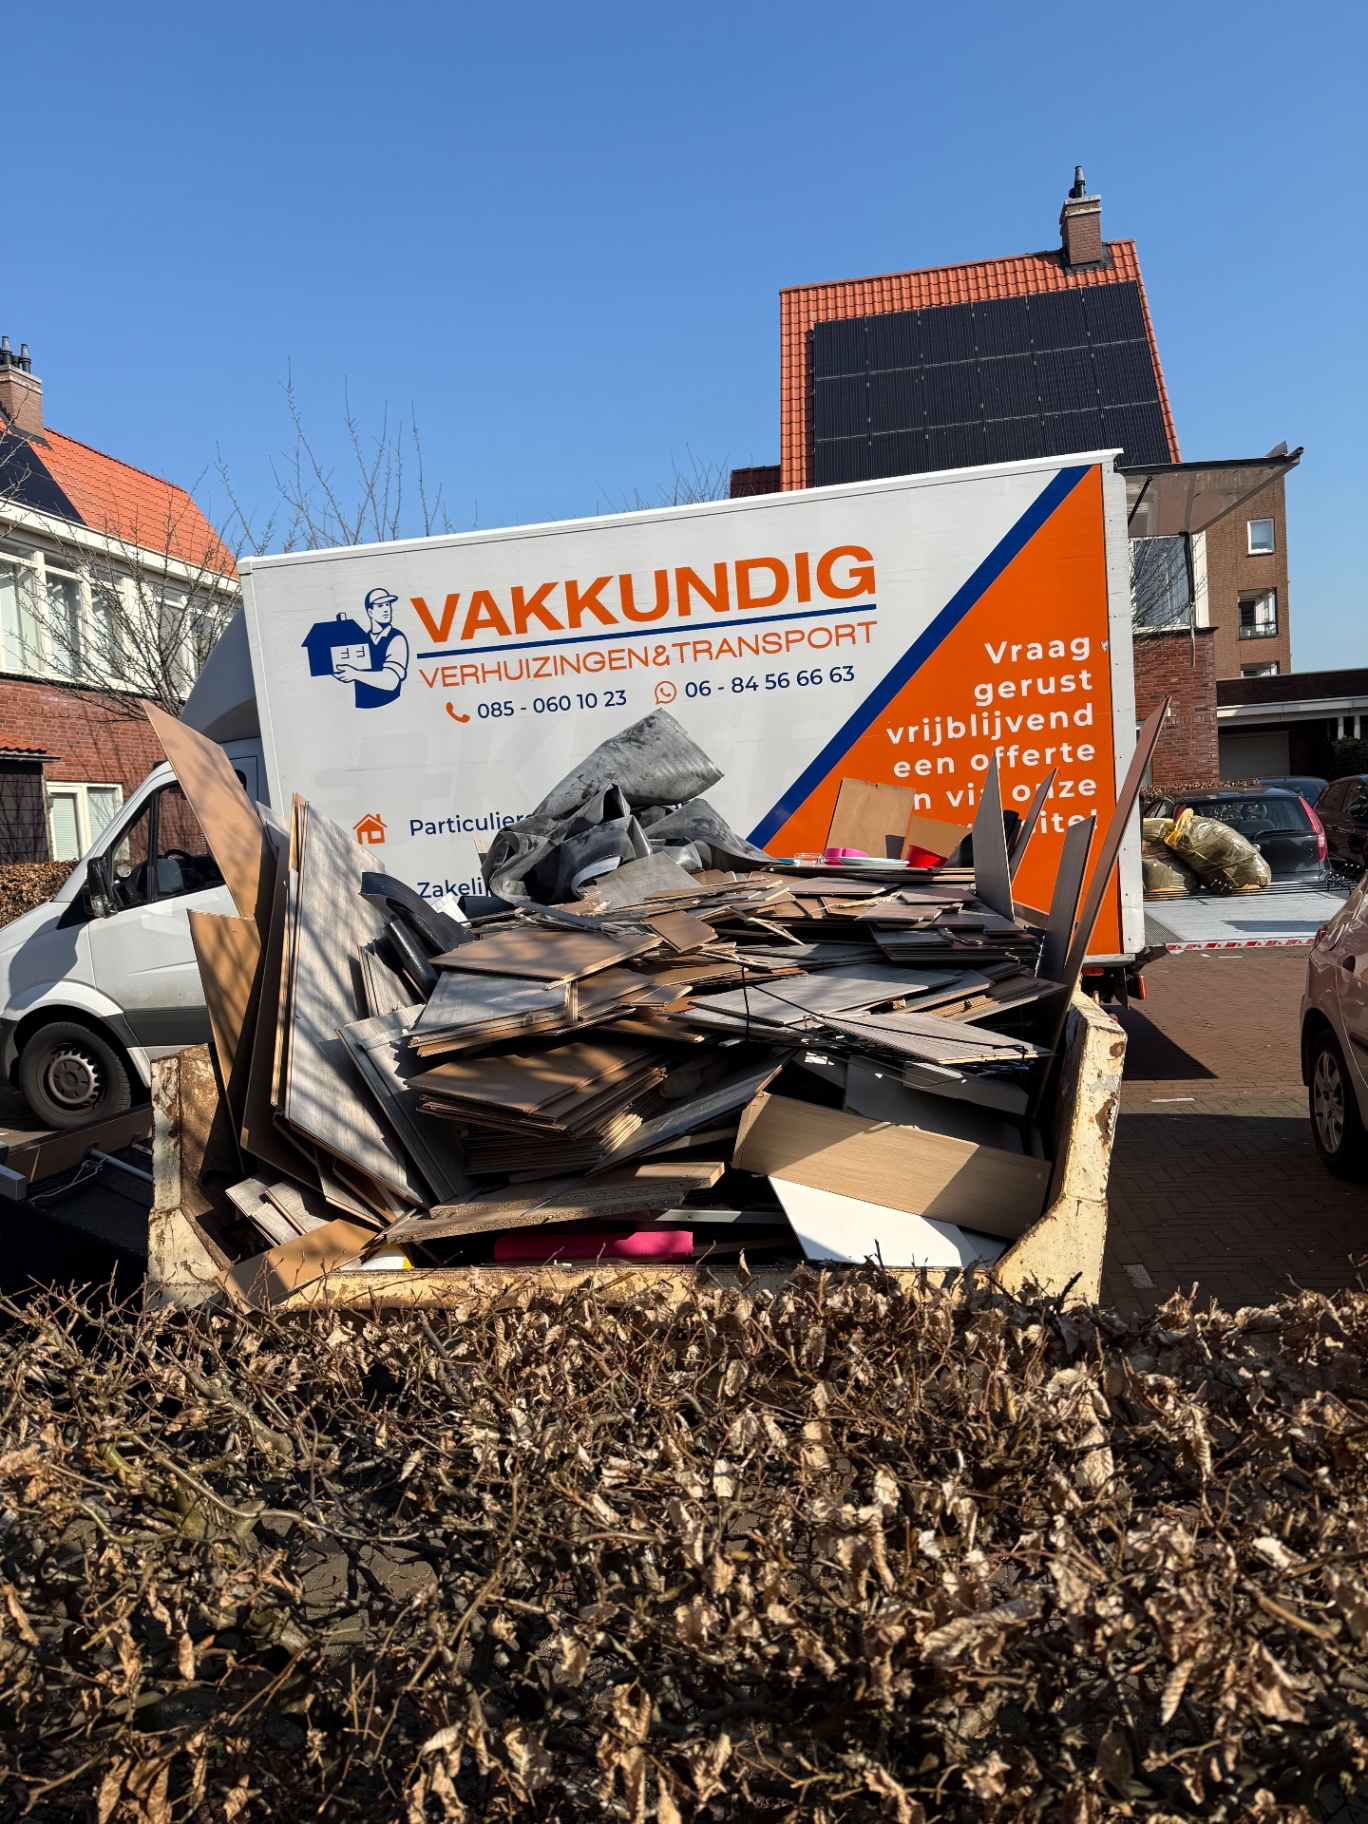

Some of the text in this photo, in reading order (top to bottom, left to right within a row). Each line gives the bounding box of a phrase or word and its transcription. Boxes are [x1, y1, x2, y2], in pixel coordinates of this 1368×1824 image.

[410, 545, 876, 643] VAKKUNDIG
[419, 620, 877, 689] VERHUIZINGEN&TRANSPORT
[984, 636, 1090, 664] Vraag
[685, 680, 712, 698] 06
[731, 675, 759, 694] 84
[765, 672, 790, 690] 56
[796, 668, 823, 687] 66
[829, 665, 855, 683] 63
[974, 669, 1093, 706] gerust
[477, 700, 515, 719] 085
[533, 695, 571, 713] 060
[577, 692, 598, 710] 10
[603, 689, 627, 708] 23
[886, 702, 1093, 746] vrijblijvend
[893, 742, 1096, 778] een offerte
[945, 782, 984, 807] vi
